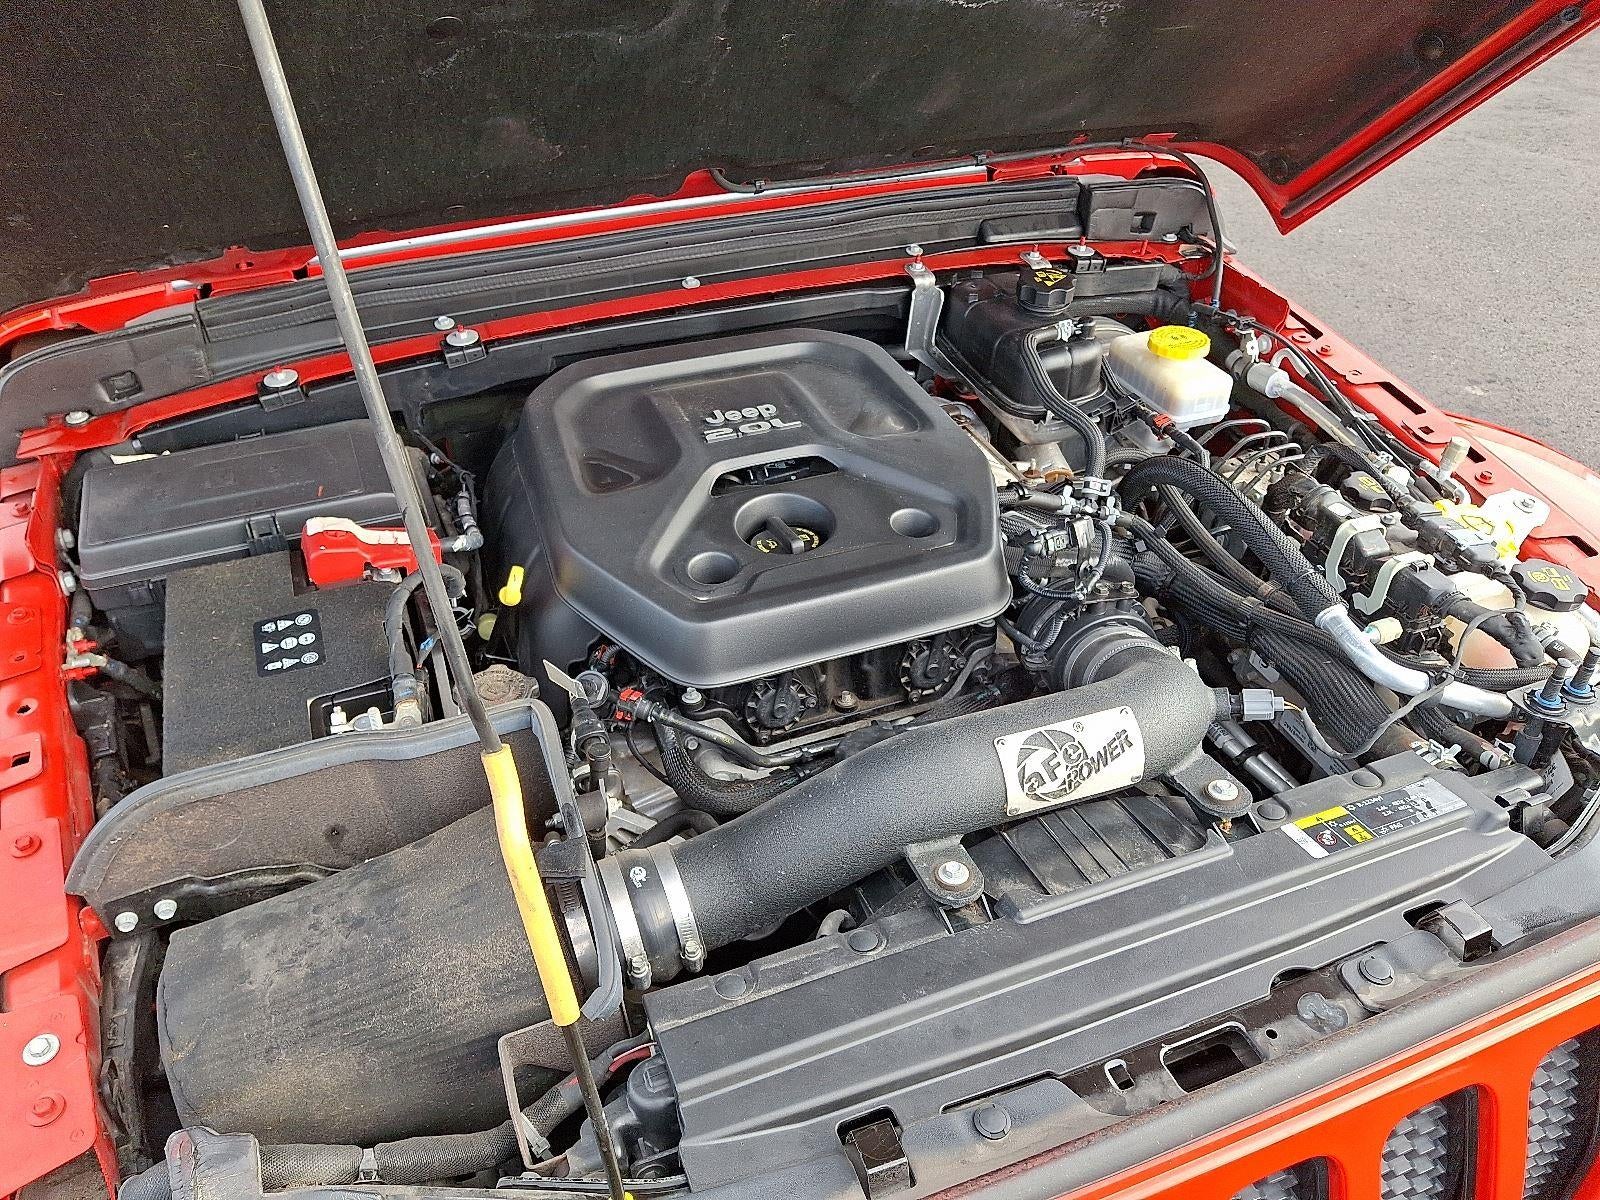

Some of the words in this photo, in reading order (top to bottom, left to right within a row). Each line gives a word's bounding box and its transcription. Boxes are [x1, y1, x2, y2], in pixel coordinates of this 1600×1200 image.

[705, 403, 777, 427] Jeep
[703, 418, 803, 444] 2.0L
[1065, 728, 1134, 794] POWER
[1388, 821, 1404, 831] PAG
